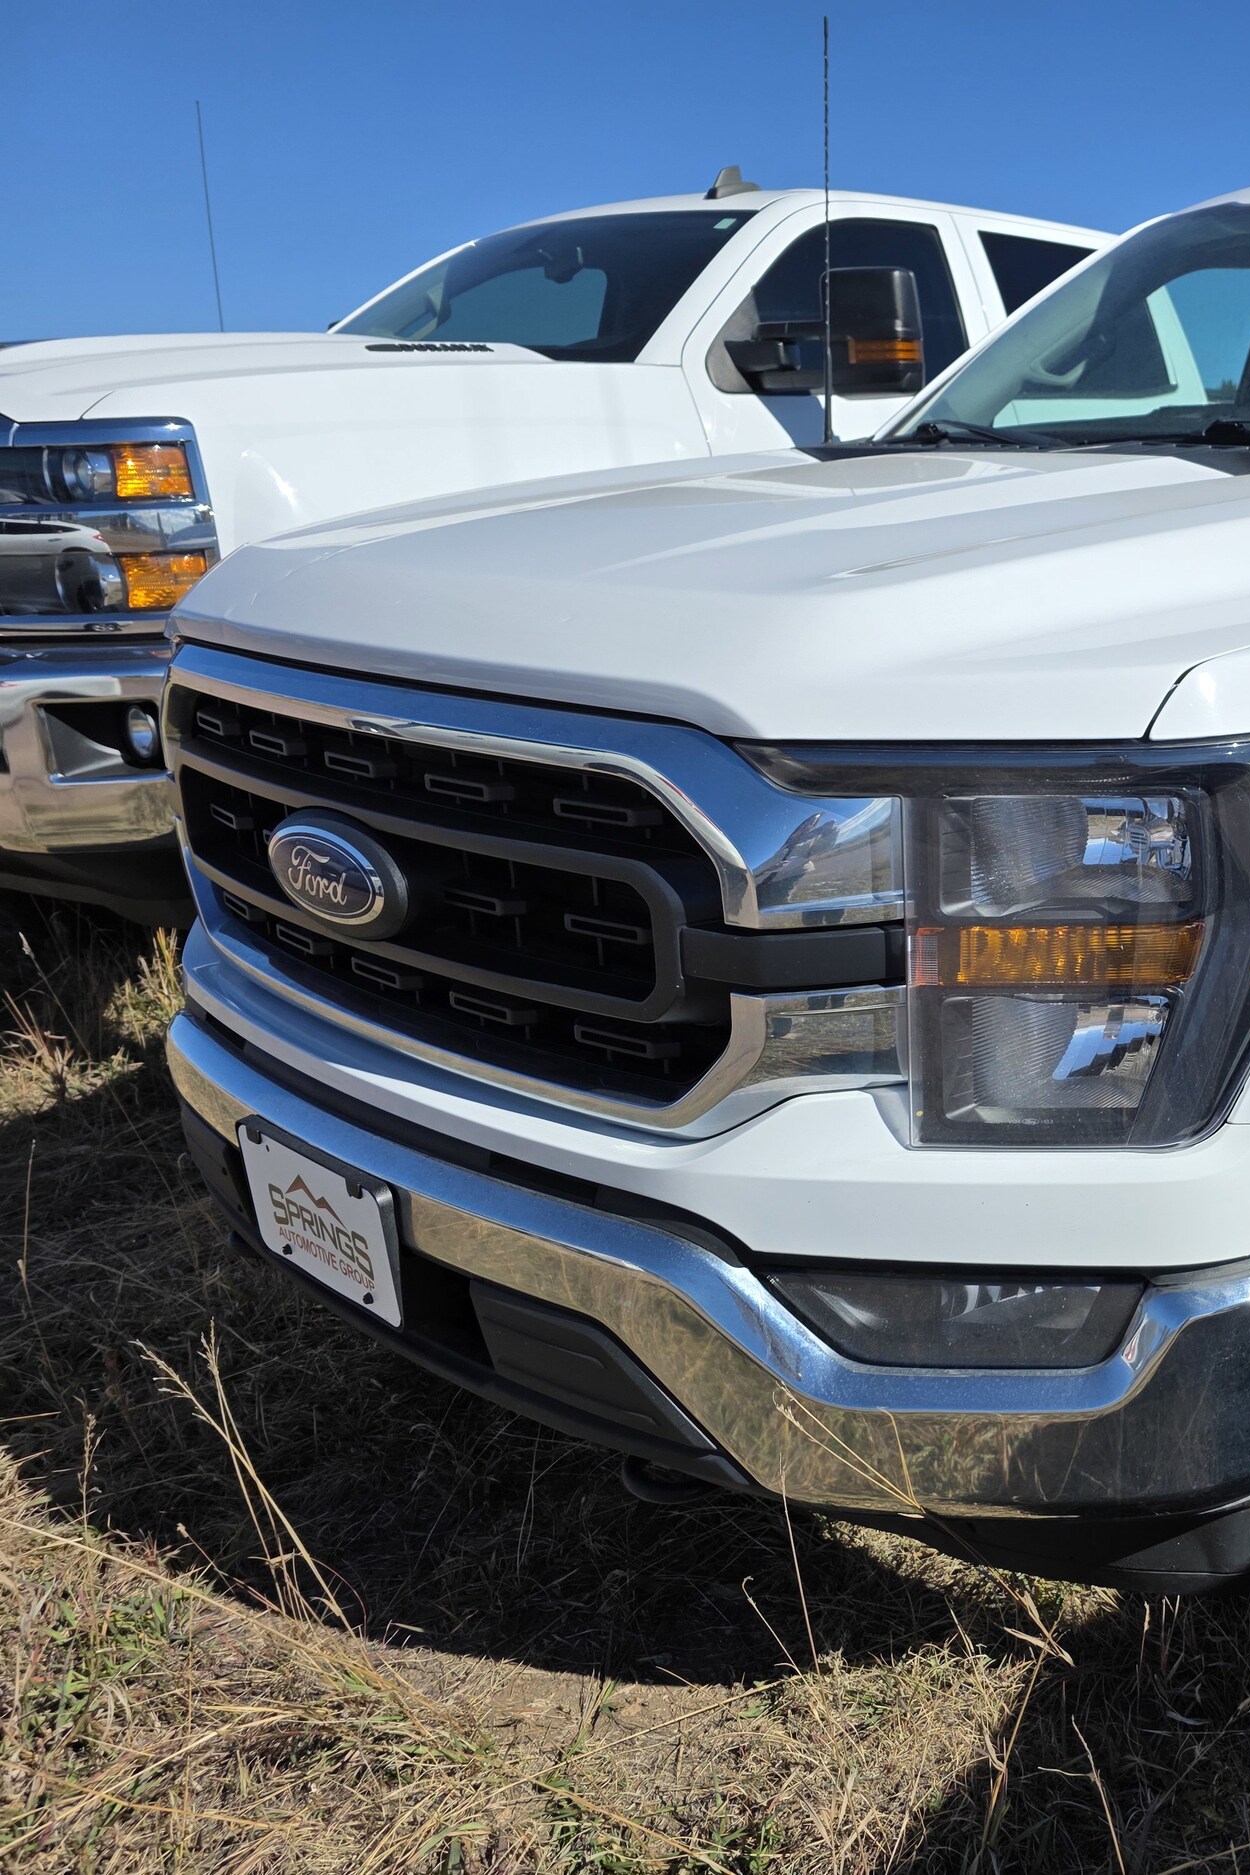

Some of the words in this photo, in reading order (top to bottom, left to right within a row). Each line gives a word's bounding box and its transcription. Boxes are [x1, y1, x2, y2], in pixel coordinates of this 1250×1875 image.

[288, 845, 347, 905] Ford
[268, 1183, 374, 1281] SPRINGS
[279, 1226, 339, 1271] AUTOMOTIVE
[340, 1259, 375, 1292] GROUP
